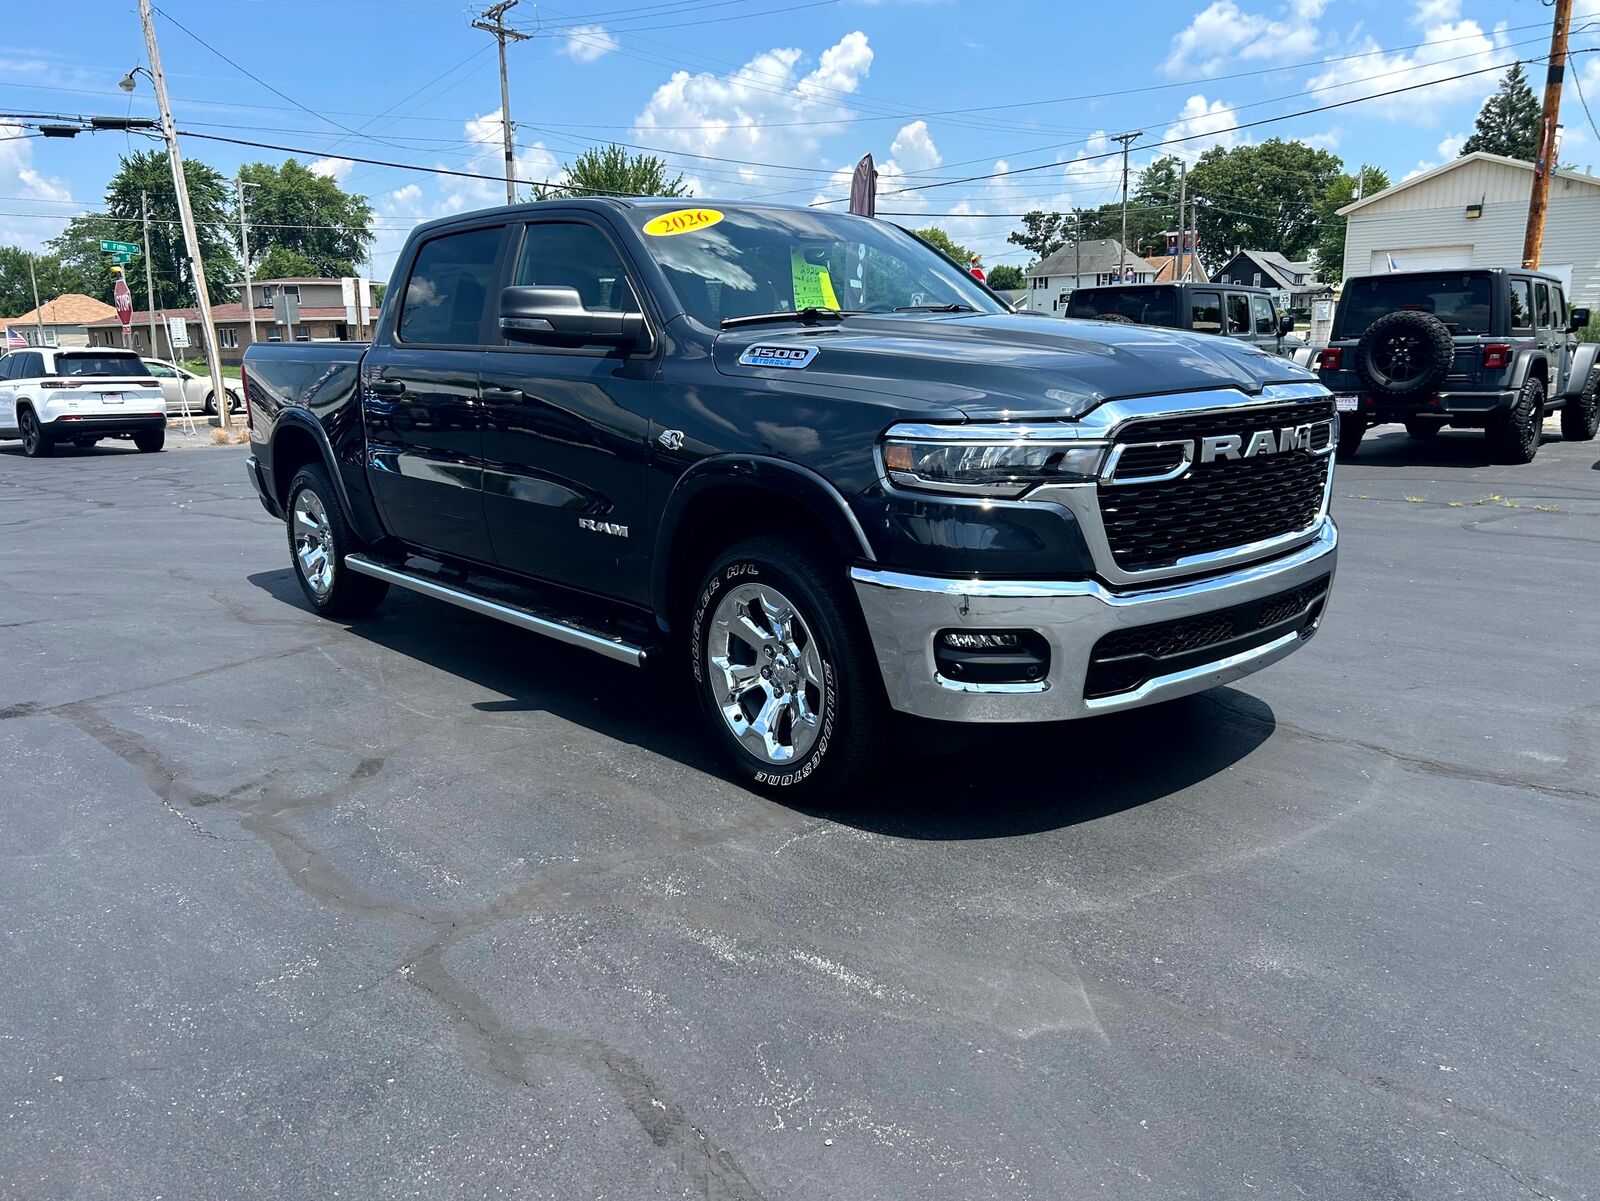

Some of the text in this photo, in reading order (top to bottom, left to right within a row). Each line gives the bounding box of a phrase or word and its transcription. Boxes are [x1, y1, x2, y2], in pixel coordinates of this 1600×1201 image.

[660, 211, 709, 233] 2026
[116, 294, 130, 312] STOP
[1281, 294, 1290, 303] 35
[754, 347, 806, 360] 1500
[1201, 426, 1310, 463] RAM
[579, 518, 628, 537] RAM
[692, 576, 720, 682] DUELER
[754, 659, 835, 786] BRIDGESTONE
